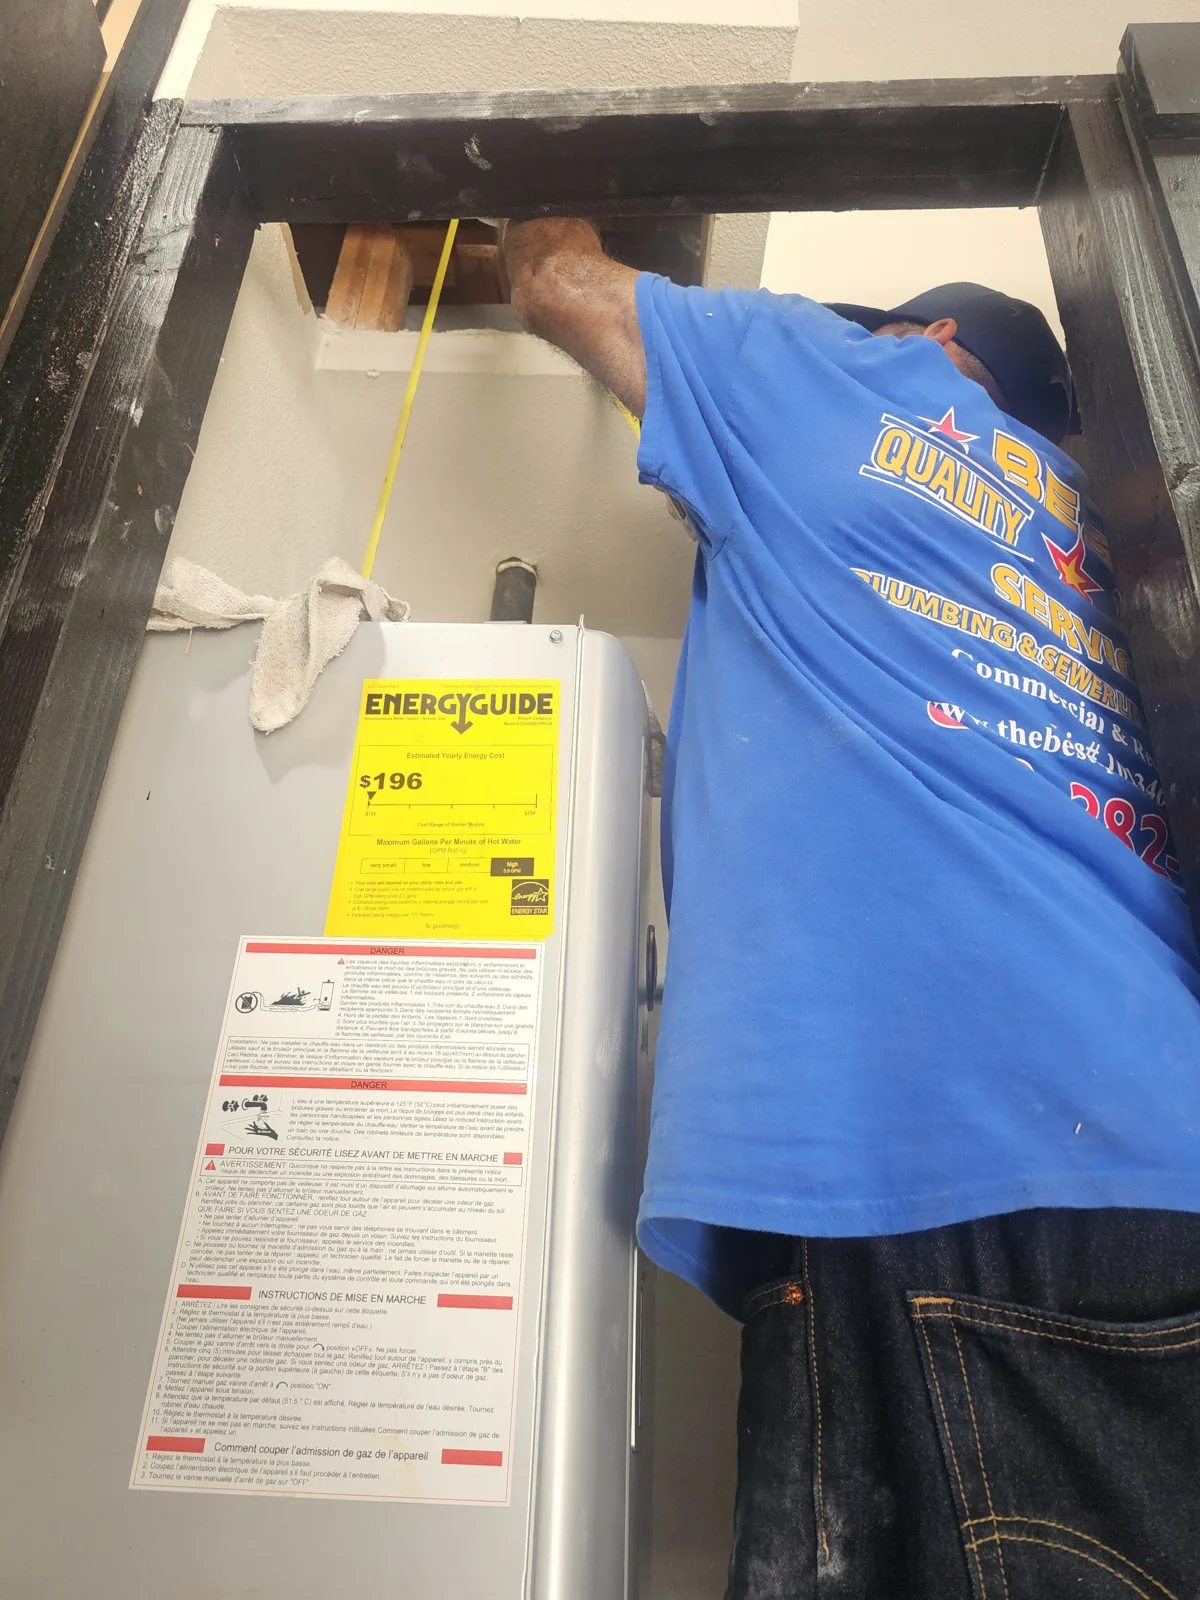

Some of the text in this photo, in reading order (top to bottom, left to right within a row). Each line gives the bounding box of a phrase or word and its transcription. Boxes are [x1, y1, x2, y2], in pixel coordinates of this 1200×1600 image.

[872, 426, 1027, 546] QUALITY
[1019, 632, 1040, 661] &
[365, 693, 553, 716] ENERGYGUIDE
[1111, 723, 1129, 746] &
[358, 772, 423, 791] $196
[228, 1146, 254, 1154] POUR
[255, 1147, 286, 1155] VOTRE
[288, 1146, 332, 1156] SÉCURITÉ
[360, 1150, 389, 1158] AVANT
[407, 1152, 443, 1160] METTRE
[460, 1153, 498, 1161] MARCHE
[219, 1160, 285, 1168] AVERTISSEMENT
[258, 1290, 426, 1304] INSTRUCTIONS DE MISE EN MARCHE
[214, 1442, 257, 1452] Comment
[258, 1446, 288, 1456] couper
[291, 1446, 340, 1456] l'admission
[355, 1451, 372, 1459] gaz
[388, 1450, 428, 1462] l'appareil
